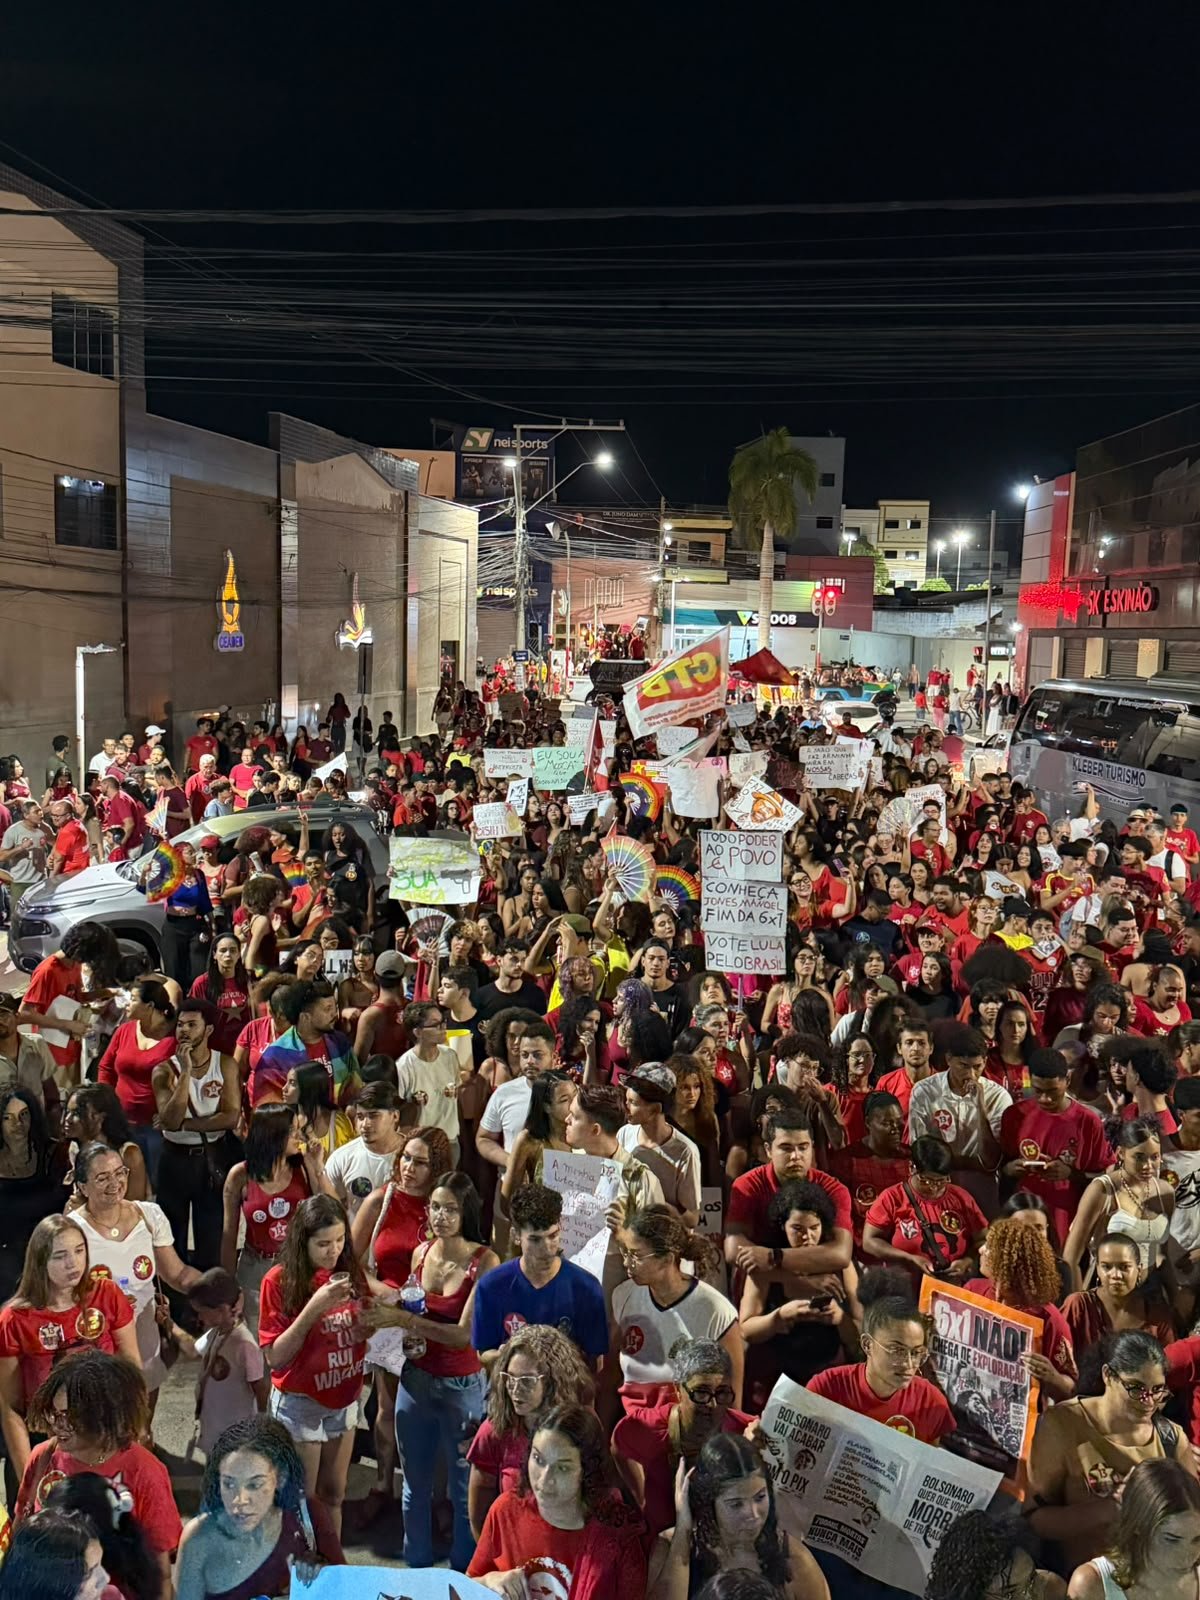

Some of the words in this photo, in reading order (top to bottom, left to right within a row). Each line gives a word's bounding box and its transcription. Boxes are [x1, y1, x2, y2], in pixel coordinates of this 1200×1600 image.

[1072, 757, 1104, 778] KLEBER
[1106, 765, 1146, 788] TURISMO
[703, 832, 736, 844] TODO
[738, 834, 777, 848] PODER
[706, 844, 724, 856] AO
[729, 846, 776, 868] POVO
[704, 896, 738, 908] JONES
[706, 882, 779, 900] CONHEÇA
[705, 908, 736, 923] FIM
[738, 909, 755, 922] DA
[706, 935, 748, 952] VOTE
[750, 939, 784, 952] LULA
[706, 952, 744, 969] PELO
[933, 1300, 972, 1346] 6x1
[974, 1315, 1028, 1363] NÃO!
[932, 1336, 960, 1362] CHEGA
[960, 1348, 972, 1366] DE
[972, 1352, 1027, 1385] EXPLORAÇÃO
[776, 1405, 832, 1440] BOLSONARO
[772, 1420, 788, 1436] VAI
[788, 1426, 826, 1454] ACABAR
[790, 1472, 810, 1494] PIX
[922, 1474, 975, 1504] BOLSONARO
[917, 1489, 936, 1504] QUER
[936, 1494, 950, 1508] QUE
[903, 1518, 914, 1530] DE
[908, 1500, 954, 1531] MORR
[808, 1526, 838, 1544] NUNCA
[838, 1536, 863, 1558] MAIS
